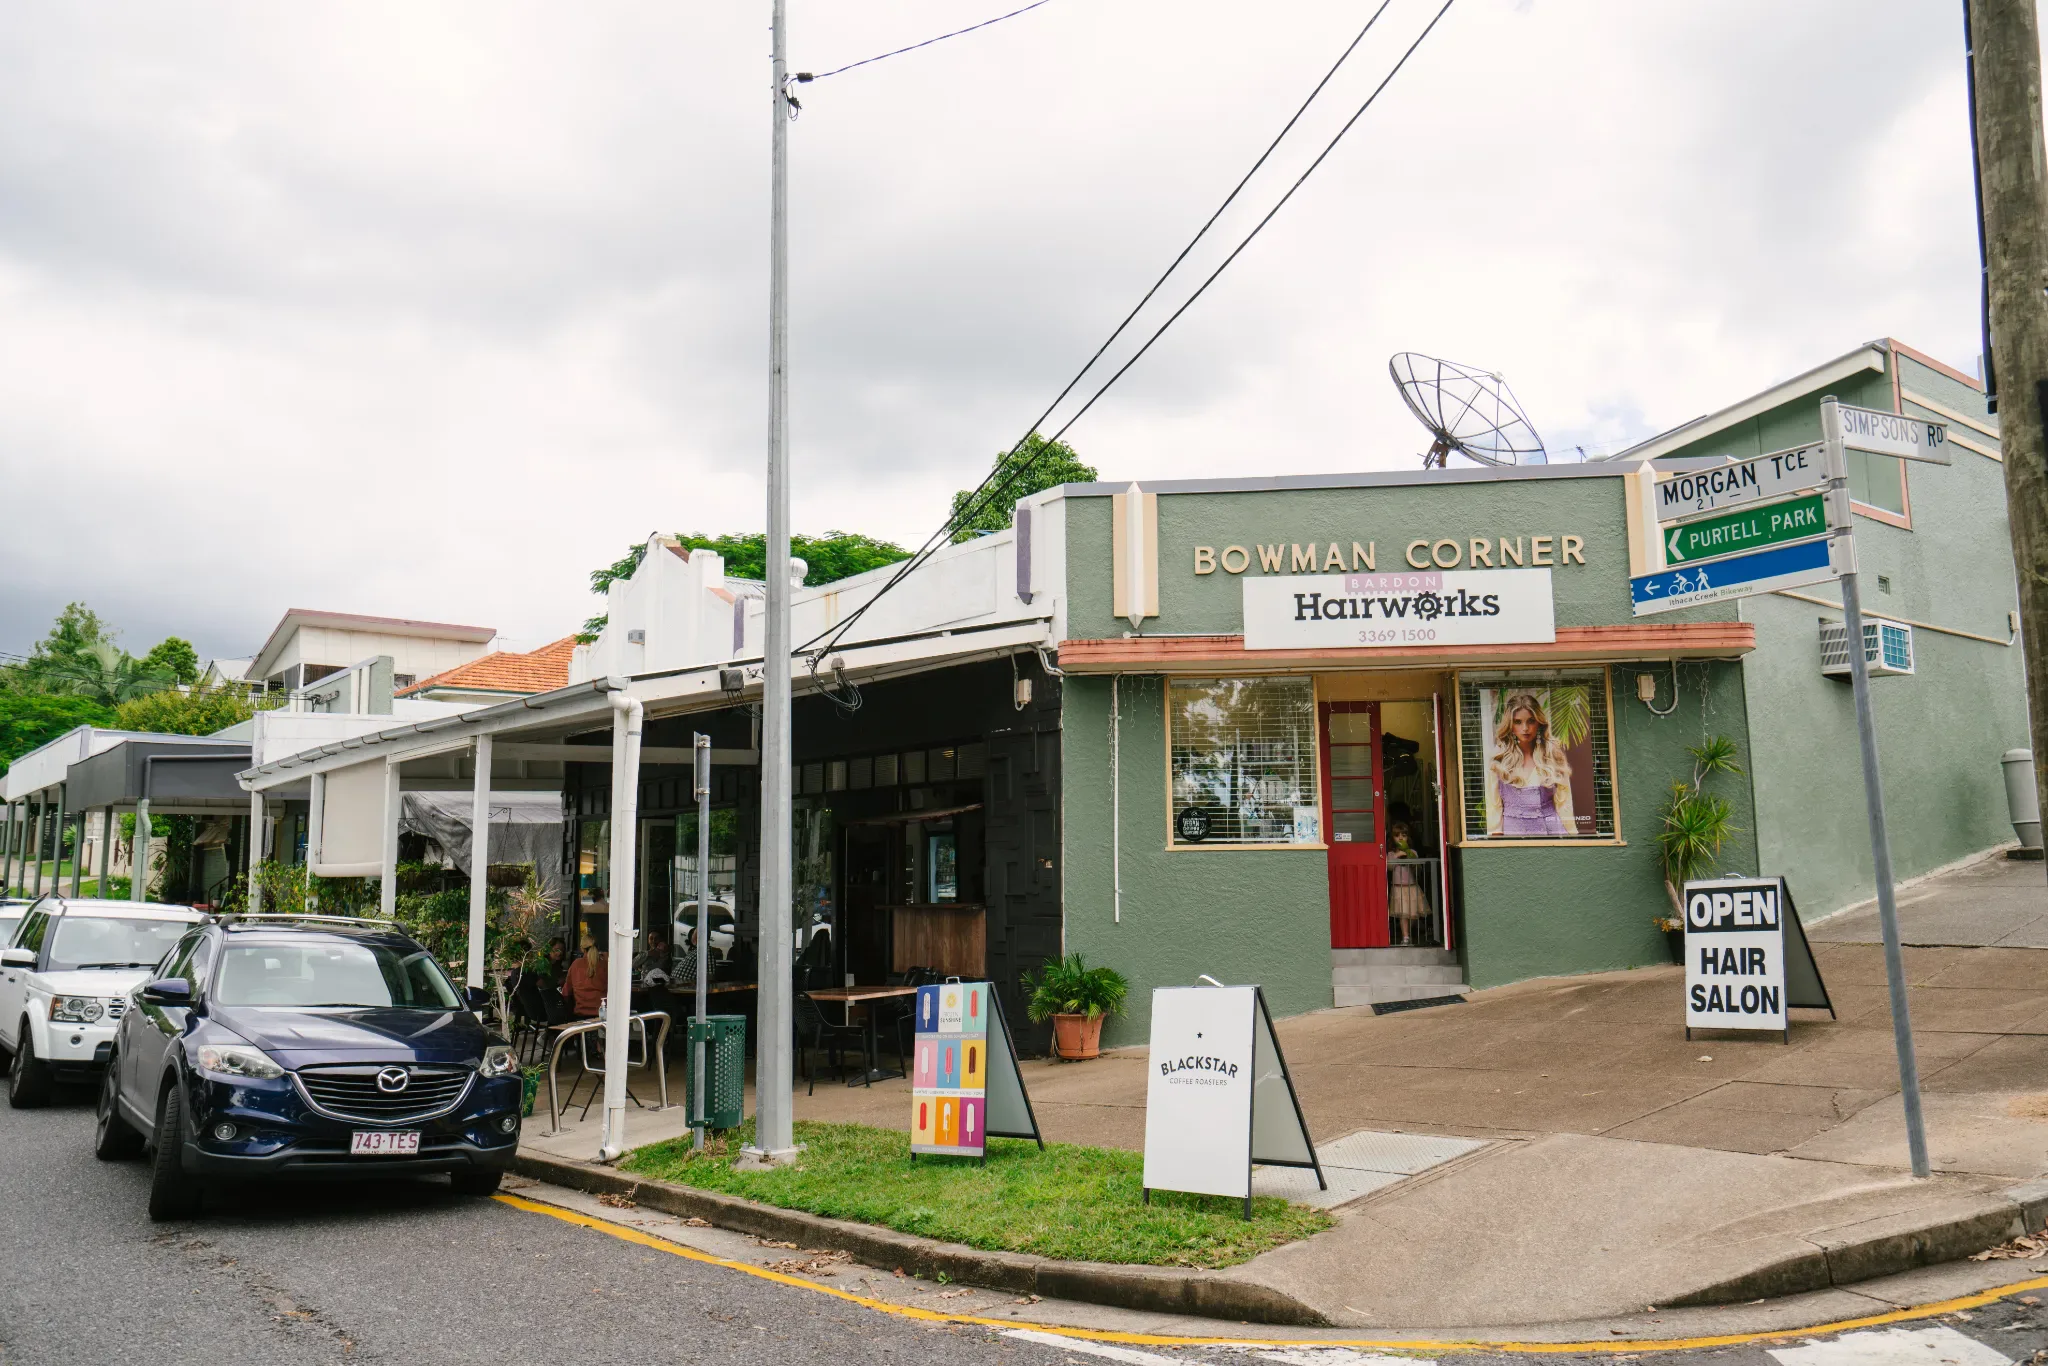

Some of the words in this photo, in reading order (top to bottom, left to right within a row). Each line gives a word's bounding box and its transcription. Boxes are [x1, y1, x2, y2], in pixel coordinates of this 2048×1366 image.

[1844, 410, 1918, 444] SIMPSONS
[1927, 424, 1943, 447] RD
[1663, 463, 1757, 505] MORGAN
[1771, 450, 1808, 479] TCE
[1697, 496, 1714, 510] 21
[1689, 520, 1762, 549] PURTELL
[1770, 507, 1817, 532] PARK
[1194, 541, 1376, 575] BOWMAN
[1405, 535, 1586, 569] CORNER
[1351, 576, 1436, 589] BARDON
[1669, 597, 1693, 606] Ithaca
[1694, 591, 1718, 600] Creek
[1720, 585, 1753, 597] Bikeway
[1293, 589, 1500, 621] Hairworks
[1358, 630, 1396, 643] 3369
[1401, 629, 1436, 641] 1500
[1689, 890, 1776, 927] OPEN
[1700, 947, 1766, 975] HAIR
[1690, 984, 1779, 1014] SALON
[1161, 1056, 1238, 1078] BLACKSTAR
[1169, 1077, 1193, 1085] COFFEE
[1195, 1078, 1228, 1086] ROASTERS
